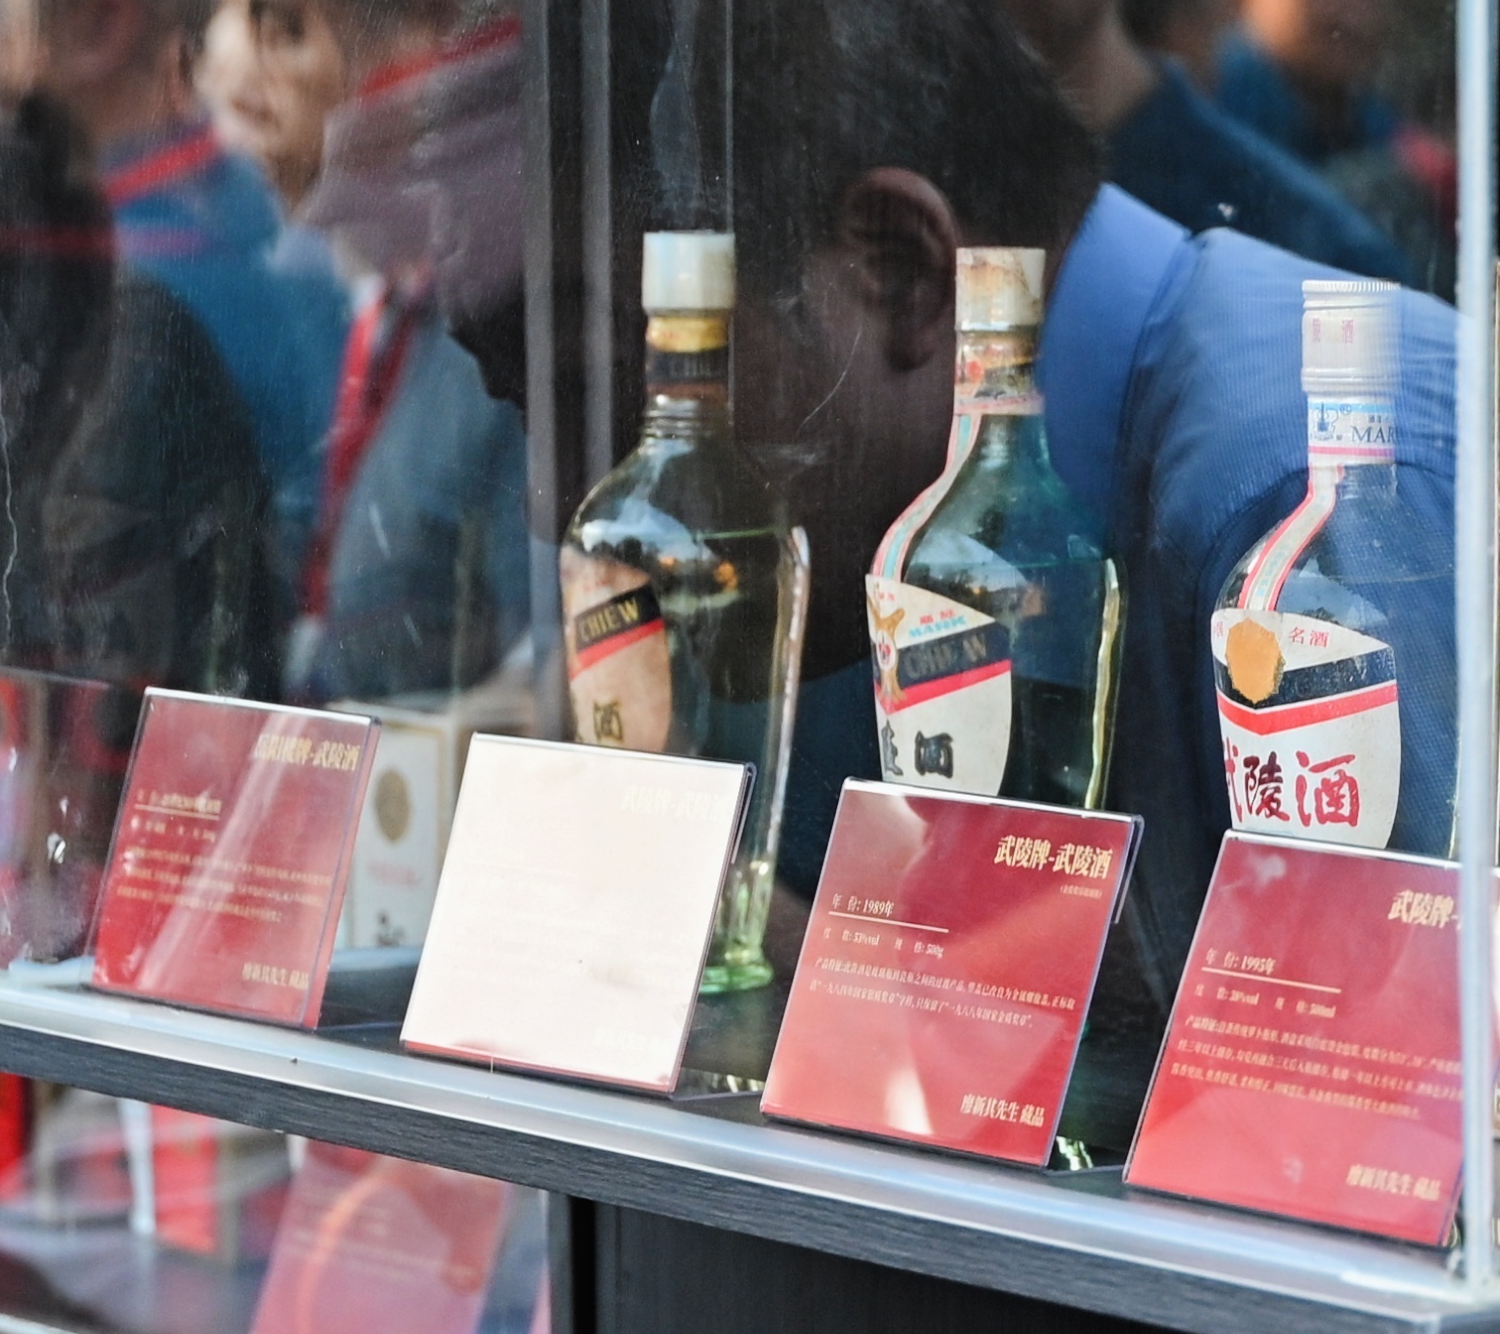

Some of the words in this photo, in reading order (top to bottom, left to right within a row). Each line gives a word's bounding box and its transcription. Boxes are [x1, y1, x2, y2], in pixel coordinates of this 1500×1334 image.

[1288, 626, 1330, 649] 名酒
[994, 834, 1114, 880] 武陵牌-武陵酒
